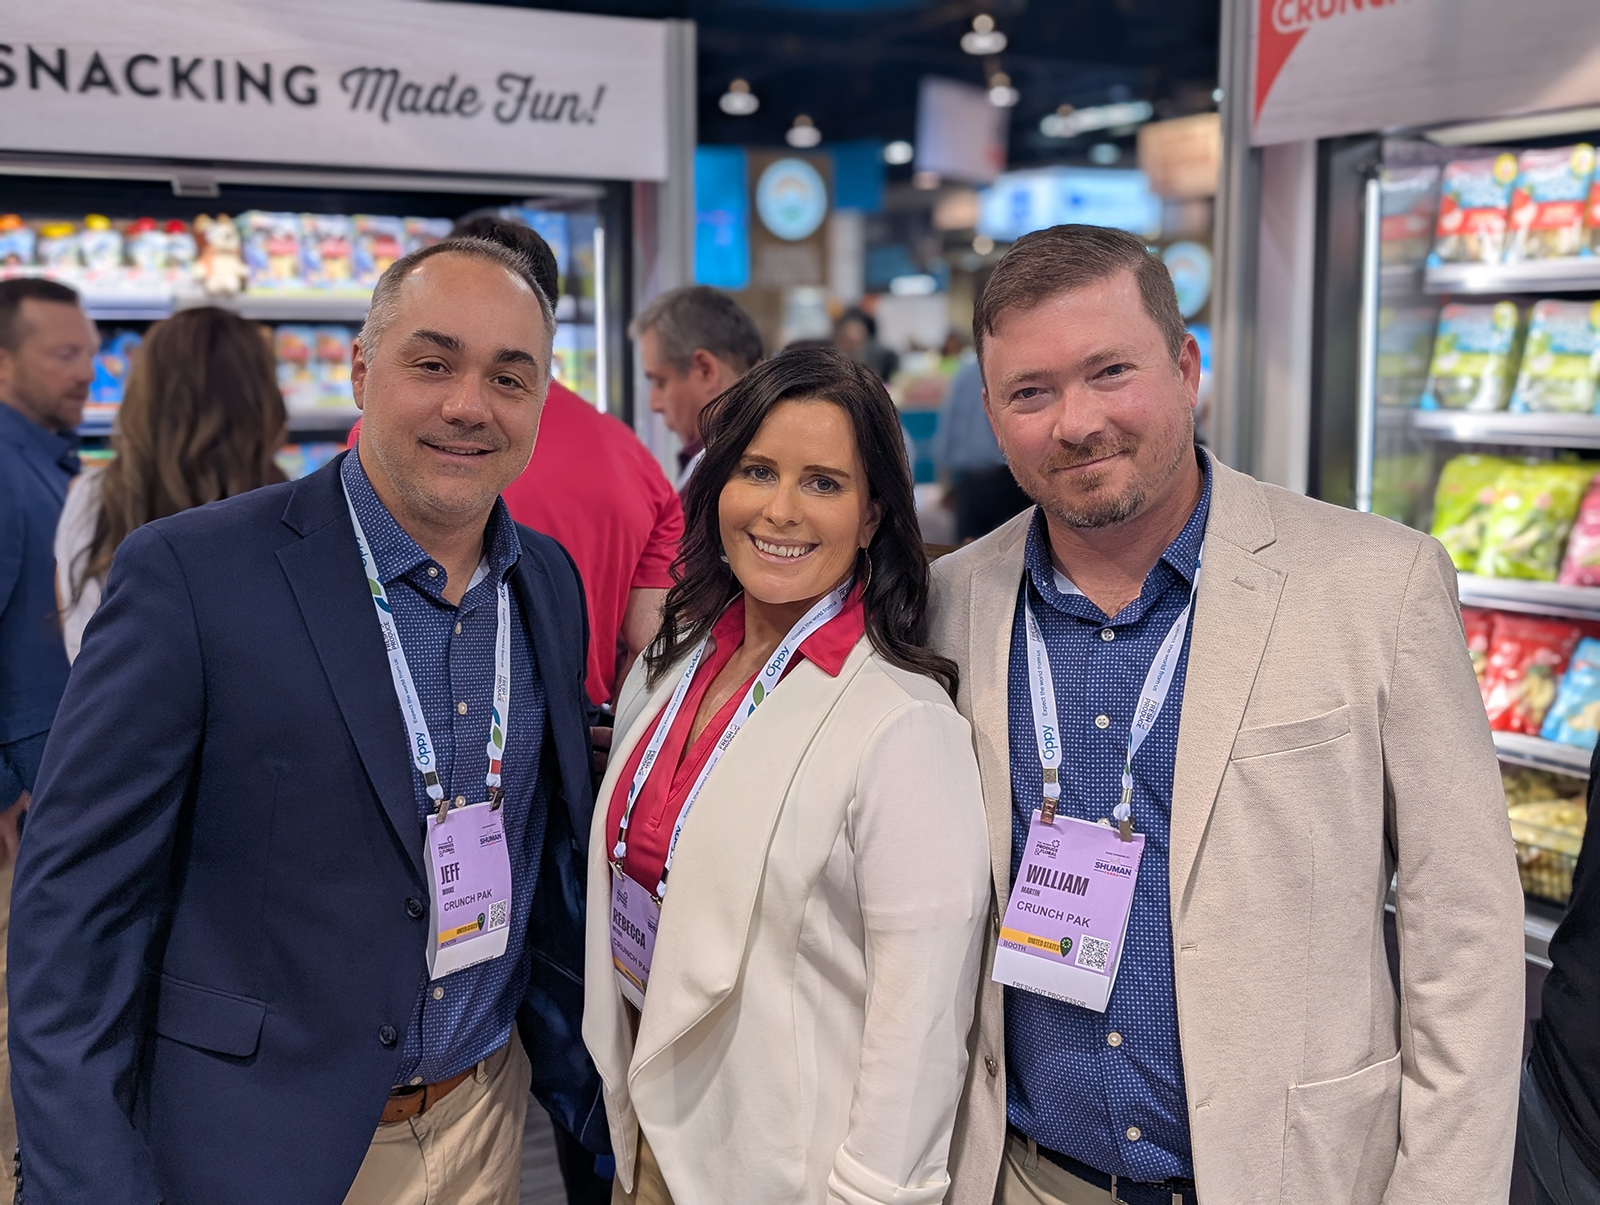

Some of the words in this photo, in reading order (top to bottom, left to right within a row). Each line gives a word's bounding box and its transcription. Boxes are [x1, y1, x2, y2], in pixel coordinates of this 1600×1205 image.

[1278, 0, 1396, 27] CRU
[0, 44, 318, 106] SNACKING
[340, 67, 484, 122] Made
[494, 72, 606, 125] Fun!
[766, 646, 790, 677] Oppy
[400, 679, 409, 694] world
[409, 704, 418, 724] Expect
[1136, 698, 1150, 730] PRODUCE
[1145, 699, 1158, 723] FRESH
[415, 732, 432, 766] Oppy
[1042, 725, 1059, 760] Oppy
[480, 833, 502, 845] SHUMAN
[1036, 843, 1058, 853] PRODUCE
[441, 862, 460, 885] JEFF
[1025, 863, 1090, 897] WILLIAM
[1094, 861, 1132, 876] SHUMAN
[444, 894, 476, 912] CRUNCH
[476, 889, 493, 902] PAK
[1020, 886, 1042, 898] MARTIN
[1016, 900, 1064, 921] CRUNCH
[1066, 913, 1092, 928] PAK
[612, 906, 646, 951] REBECCA
[612, 937, 638, 965] CRUNCH
[1003, 940, 1026, 952] BOOTH
[1027, 936, 1043, 947] UNITED
[1042, 940, 1060, 952] STATES
